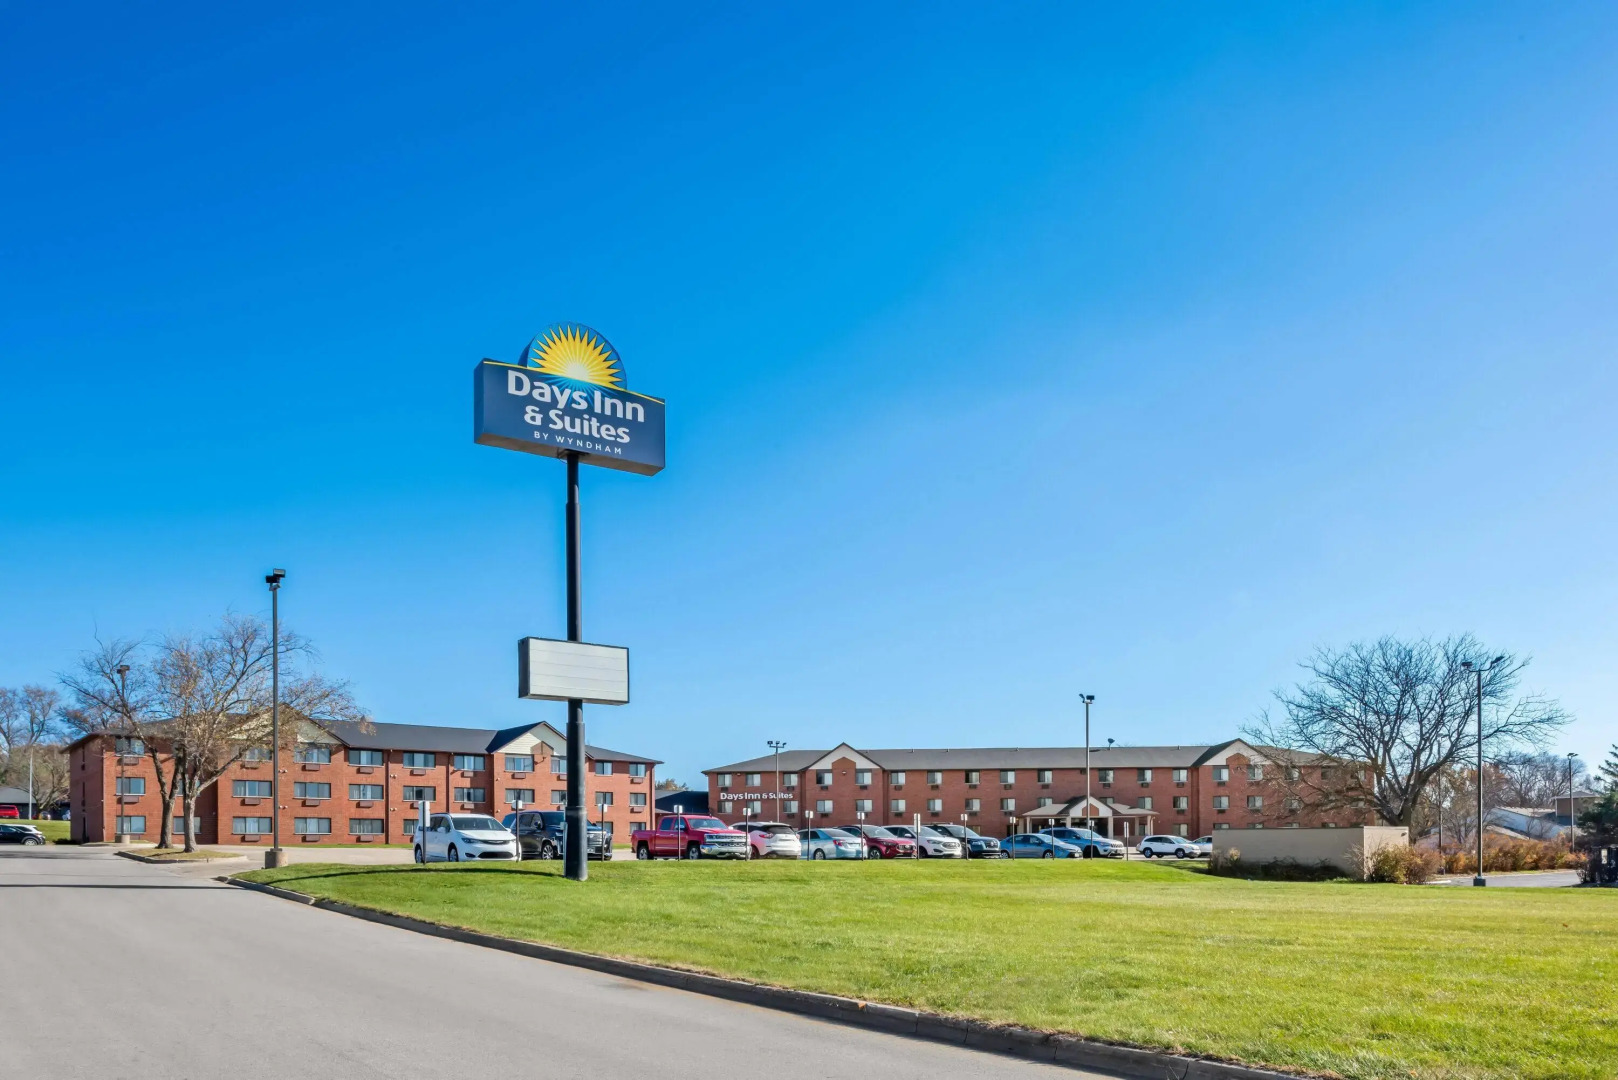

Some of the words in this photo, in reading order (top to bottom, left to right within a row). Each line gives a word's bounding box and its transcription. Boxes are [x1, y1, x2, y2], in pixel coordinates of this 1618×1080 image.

[508, 369, 587, 409] Days
[594, 390, 645, 422] Inn
[524, 405, 543, 426] &
[549, 409, 631, 443] Suites
[534, 430, 549, 440] BY
[555, 435, 622, 454] WYNDHAM
[720, 792, 743, 800] Days
